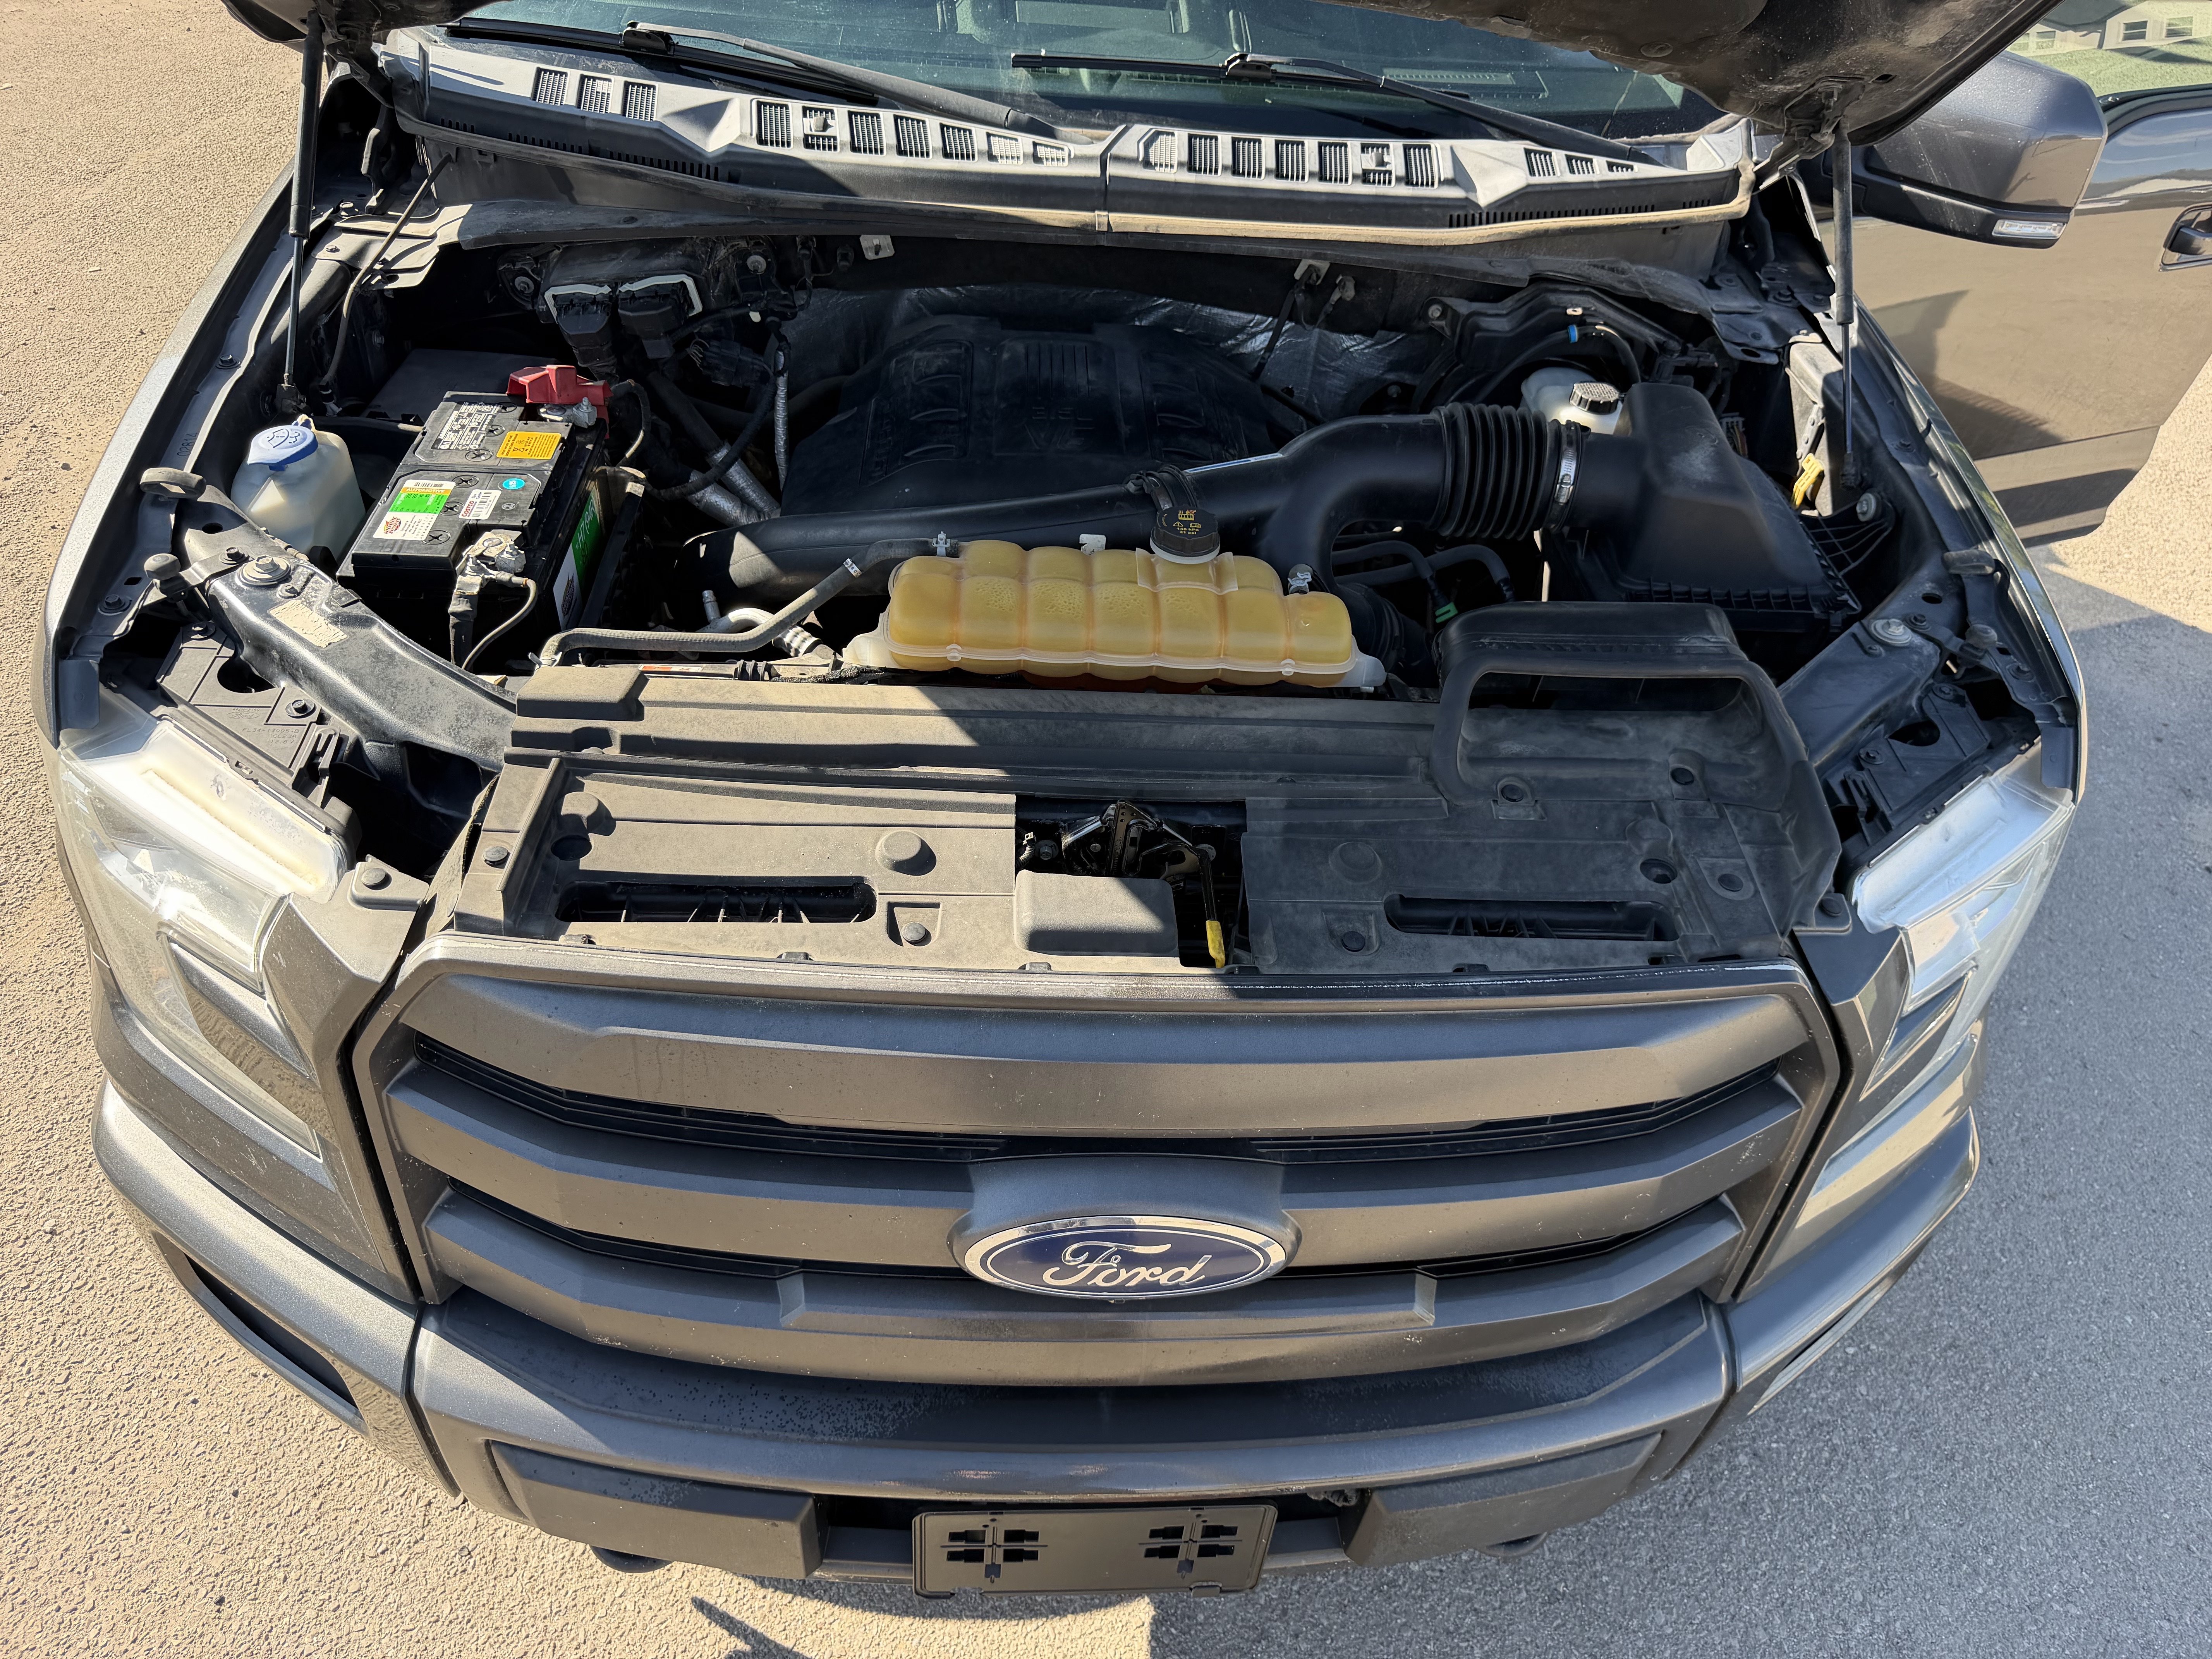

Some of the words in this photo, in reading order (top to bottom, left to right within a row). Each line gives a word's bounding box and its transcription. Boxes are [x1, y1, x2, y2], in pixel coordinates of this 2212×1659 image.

[461, 500, 474, 517] COSTCO
[383, 516, 397, 534] INTERSTATE
[389, 518, 400, 534] BATTERIES
[1043, 1240, 1212, 1286] Ford
